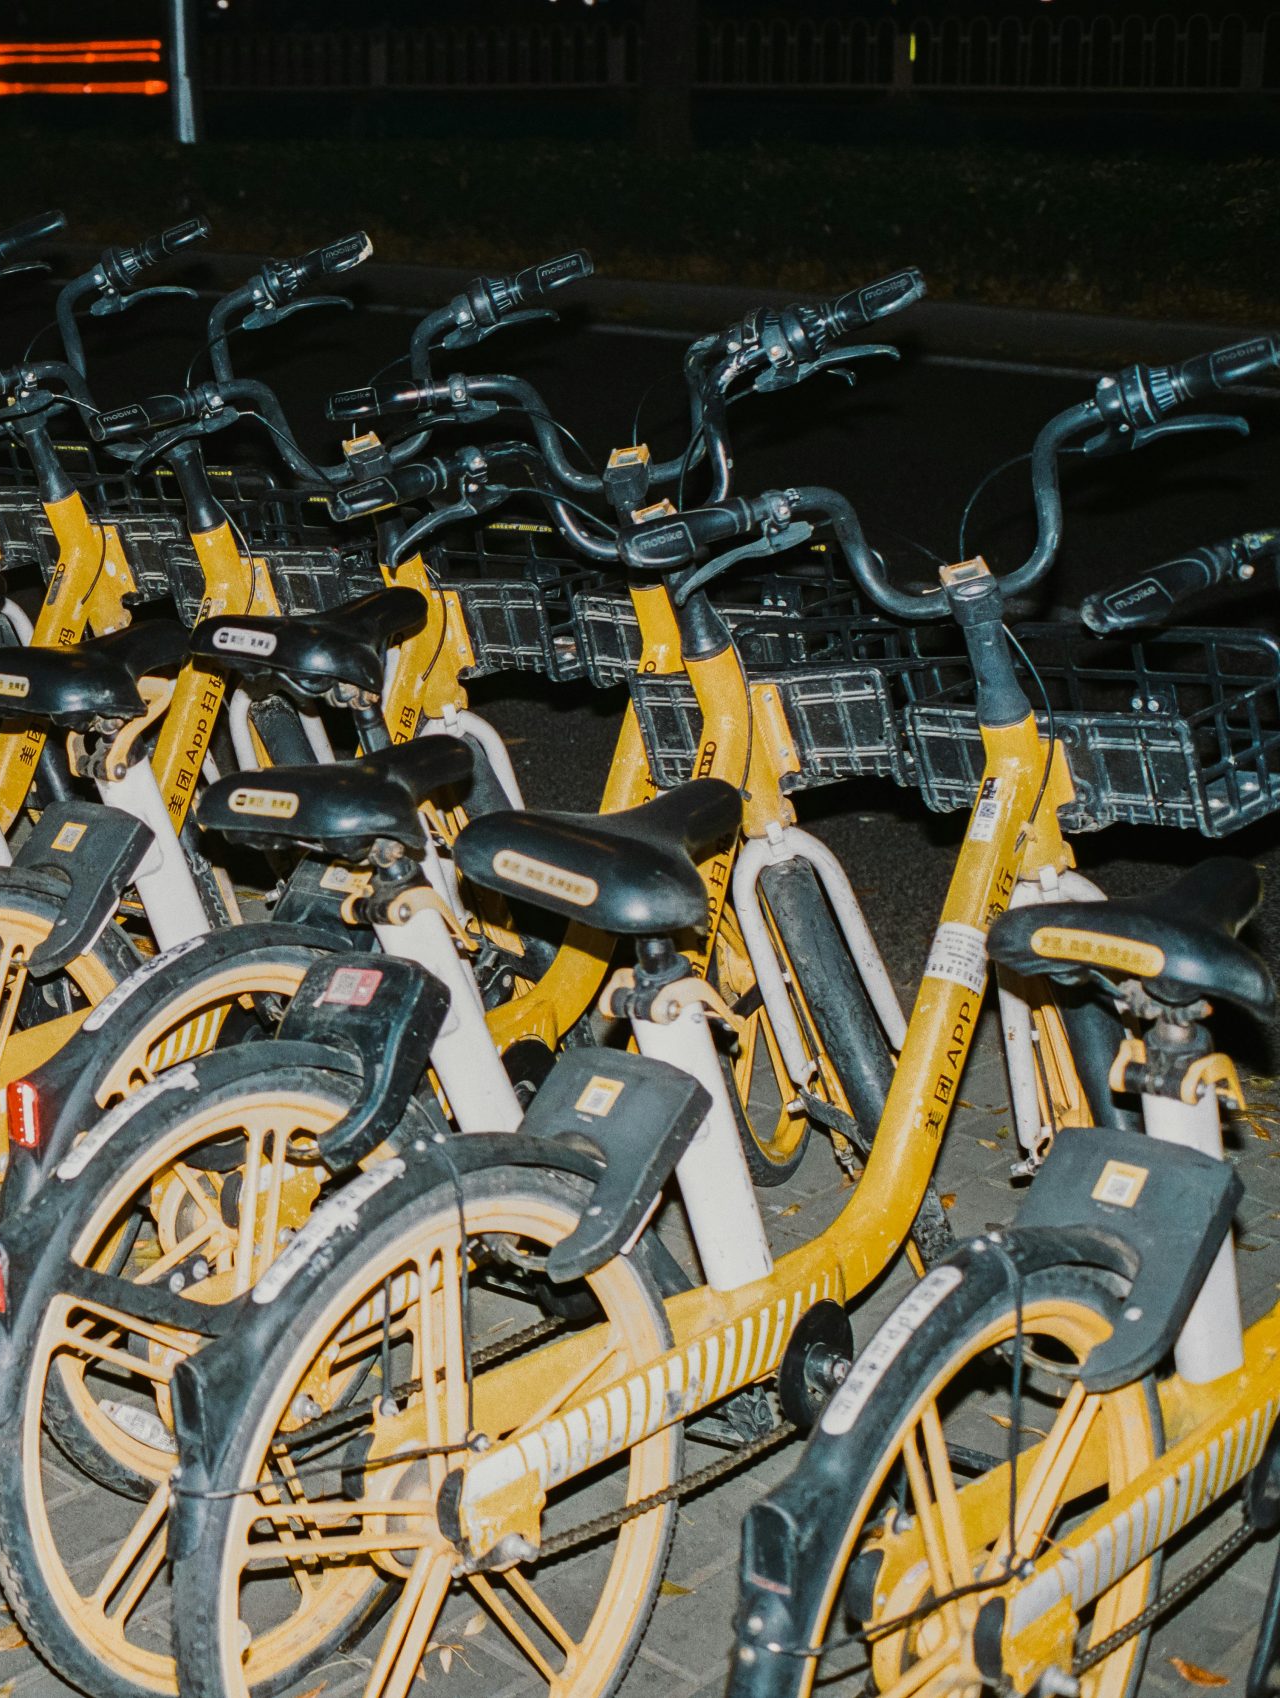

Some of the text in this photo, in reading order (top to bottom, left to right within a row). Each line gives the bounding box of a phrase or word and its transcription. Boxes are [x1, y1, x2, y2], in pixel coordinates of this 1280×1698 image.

[541, 259, 577, 277] mobike
[1216, 344, 1265, 363] mobike
[103, 408, 138, 422] mobike
[640, 530, 684, 550] mobike
[925, 990, 977, 1139] 美团APP
